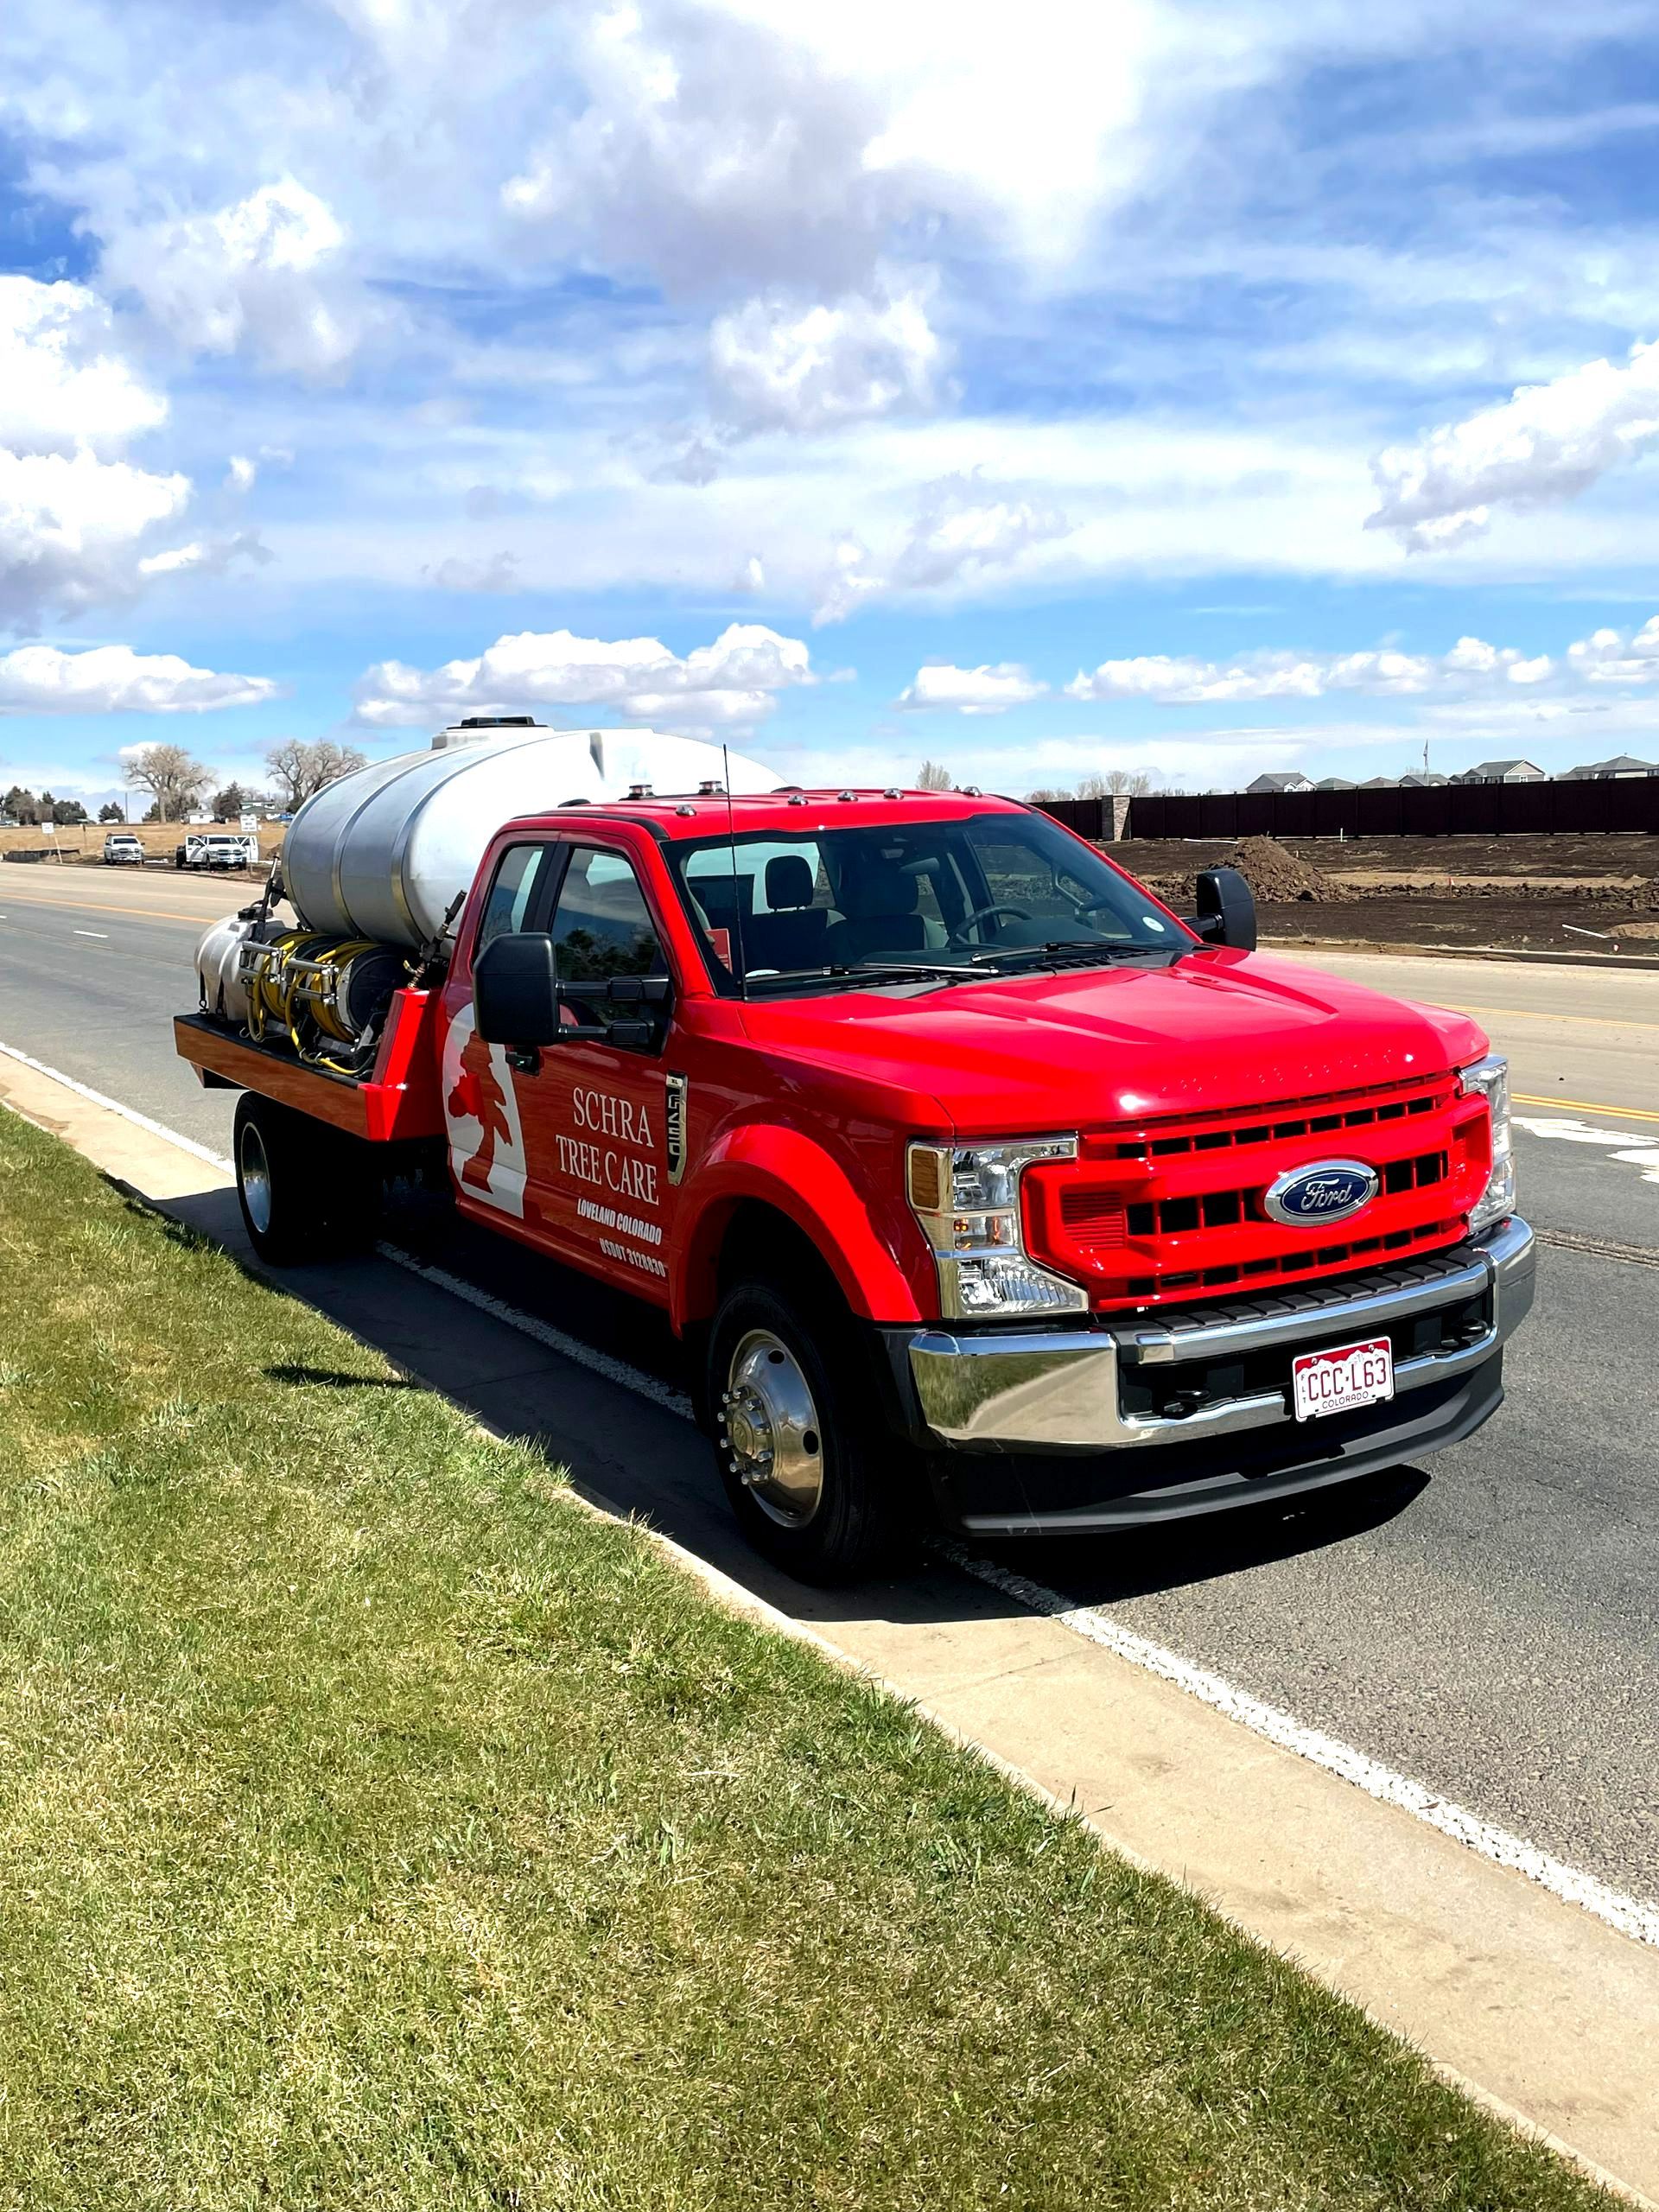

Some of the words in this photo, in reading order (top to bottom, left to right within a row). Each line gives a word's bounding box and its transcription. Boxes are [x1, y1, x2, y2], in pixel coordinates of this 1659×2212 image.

[573, 1087, 654, 1148] SCHRA
[556, 1135, 601, 1185] TREE
[605, 1151, 659, 1205] CARE
[1300, 1178, 1353, 1210] Ford
[577, 1198, 616, 1227] LOVELAND
[616, 1212, 662, 1245] COLORADO
[599, 1237, 626, 1262] USDOT
[1322, 1390, 1369, 1409] COLORADO
